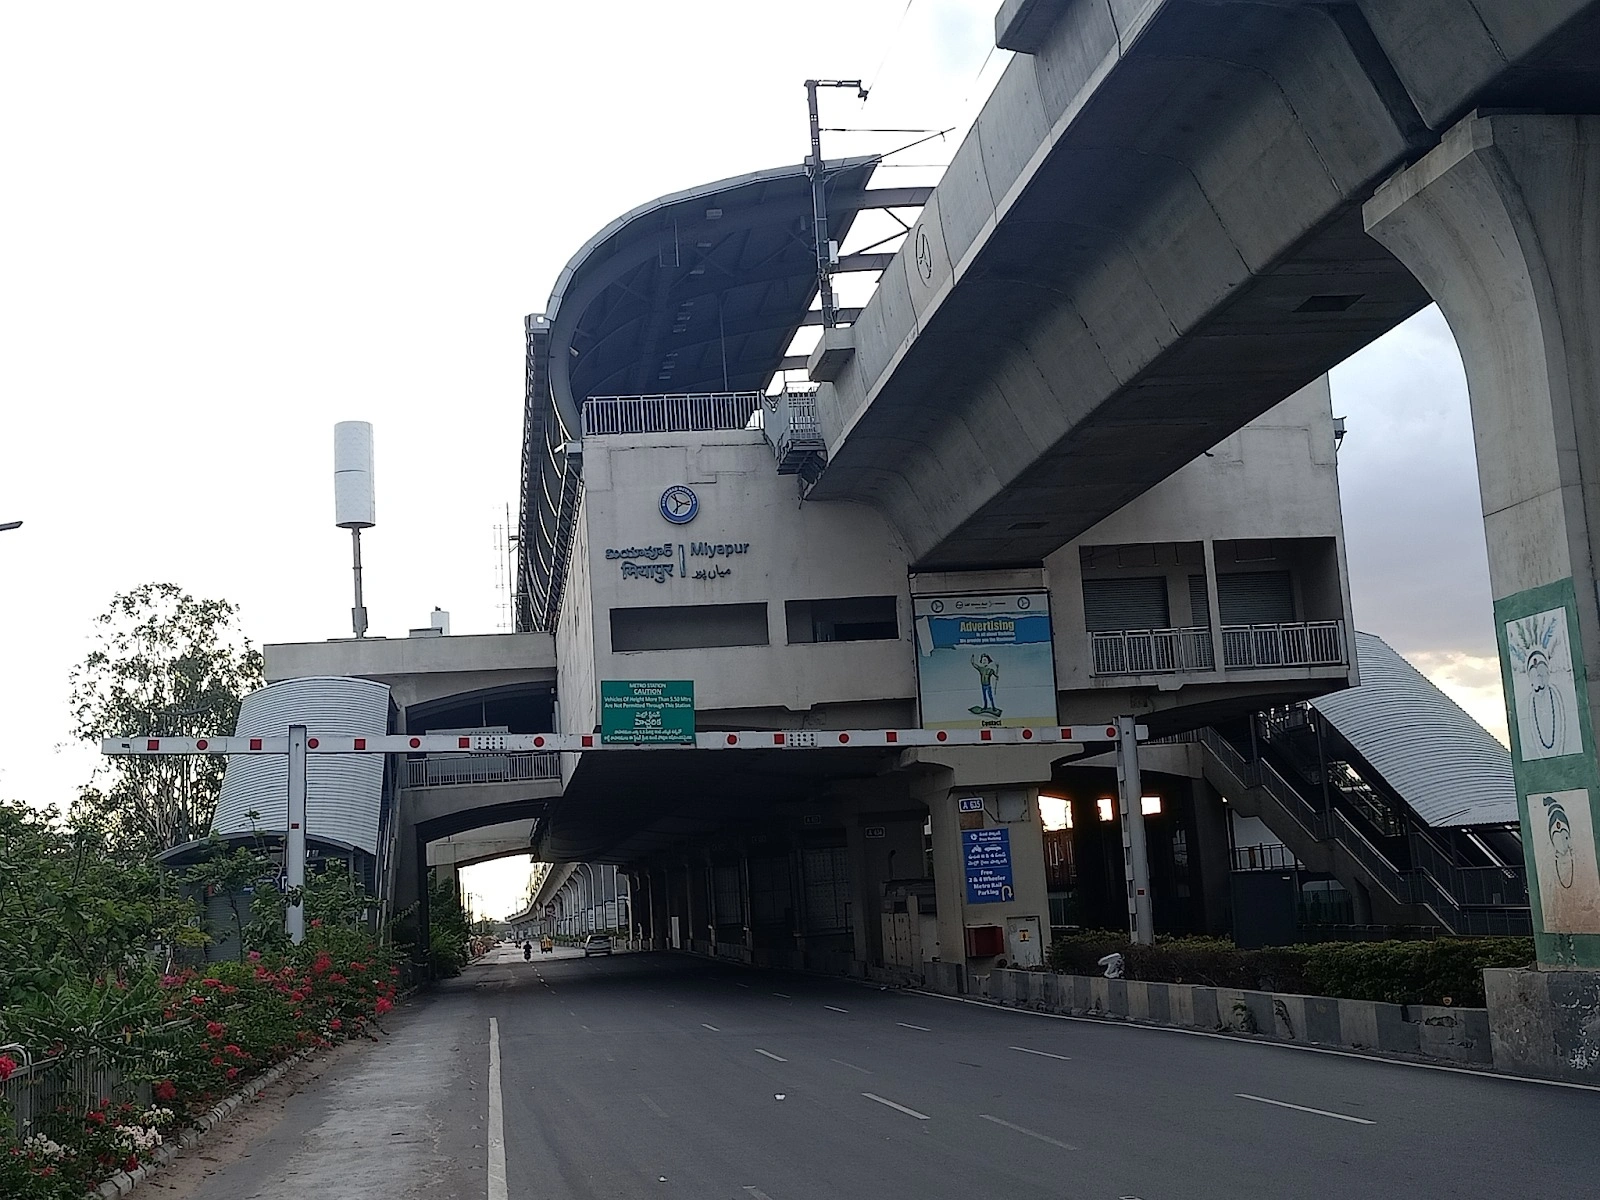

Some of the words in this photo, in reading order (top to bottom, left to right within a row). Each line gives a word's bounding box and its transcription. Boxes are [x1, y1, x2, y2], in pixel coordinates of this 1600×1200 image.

[690, 542, 750, 558] Miyapur
[960, 620, 1015, 632] Advertising
[963, 801, 968, 809] A
[970, 800, 980, 809] 635
